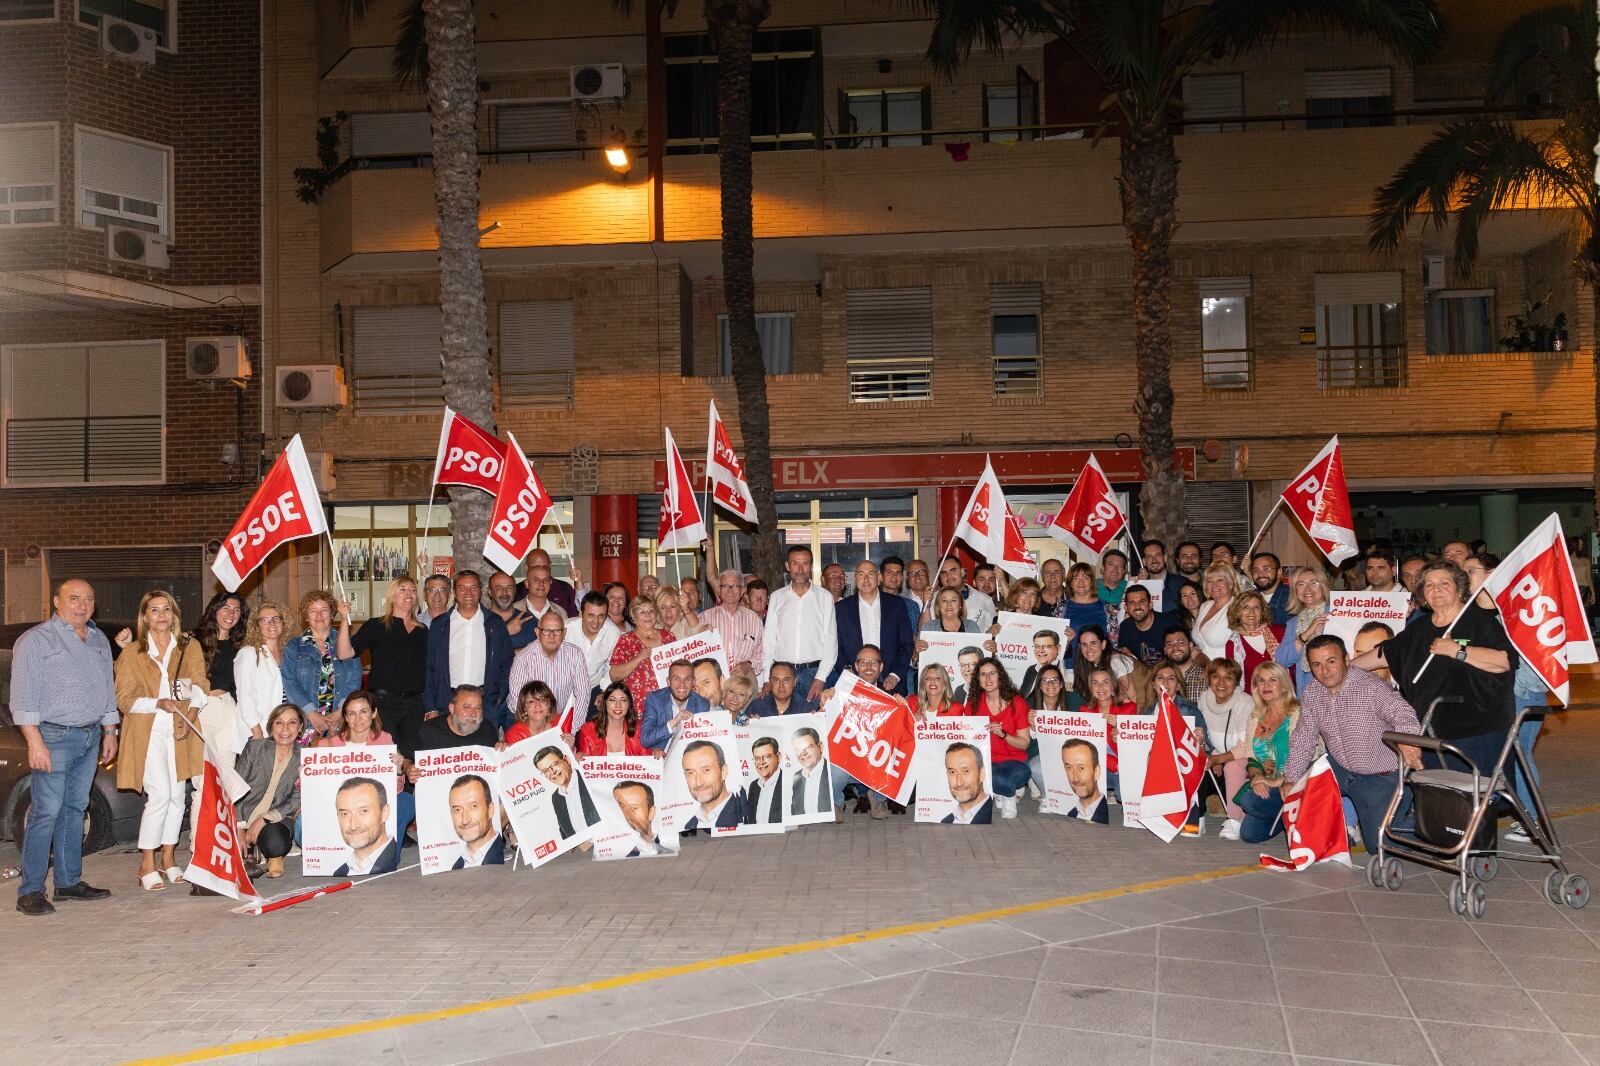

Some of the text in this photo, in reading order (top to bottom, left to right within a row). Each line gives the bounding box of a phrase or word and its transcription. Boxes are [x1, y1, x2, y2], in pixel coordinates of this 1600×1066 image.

[782, 461, 829, 485] ELX
[1296, 475, 1323, 513] PS
[972, 502, 990, 525] PS
[230, 490, 301, 562] PSOE
[1081, 500, 1116, 545] PSO
[600, 534, 622, 545] PSOE
[603, 546, 620, 557] ELX
[1333, 597, 1391, 608] el alcalde.
[1331, 609, 1404, 619] Carlos González
[653, 640, 707, 661] el alcalde.
[684, 644, 721, 661] González
[1001, 643, 1028, 654] VOTA
[917, 722, 927, 731] el
[1036, 715, 1091, 727] el alcalde.
[1120, 720, 1155, 730] el alca
[685, 729, 728, 739] González
[1038, 726, 1104, 738] Carlos González
[1120, 732, 1148, 740] Carlos
[832, 720, 906, 779] PSOE
[1176, 727, 1200, 775] OE
[304, 752, 376, 764] el alcalde.
[419, 751, 483, 767] el alcalde.
[304, 764, 393, 776] Carlos González
[420, 764, 498, 778] Carlos González
[583, 762, 594, 770] el
[506, 778, 542, 799] VOTA
[513, 787, 546, 806] XIMO PUIG
[210, 776, 233, 875] SOE
